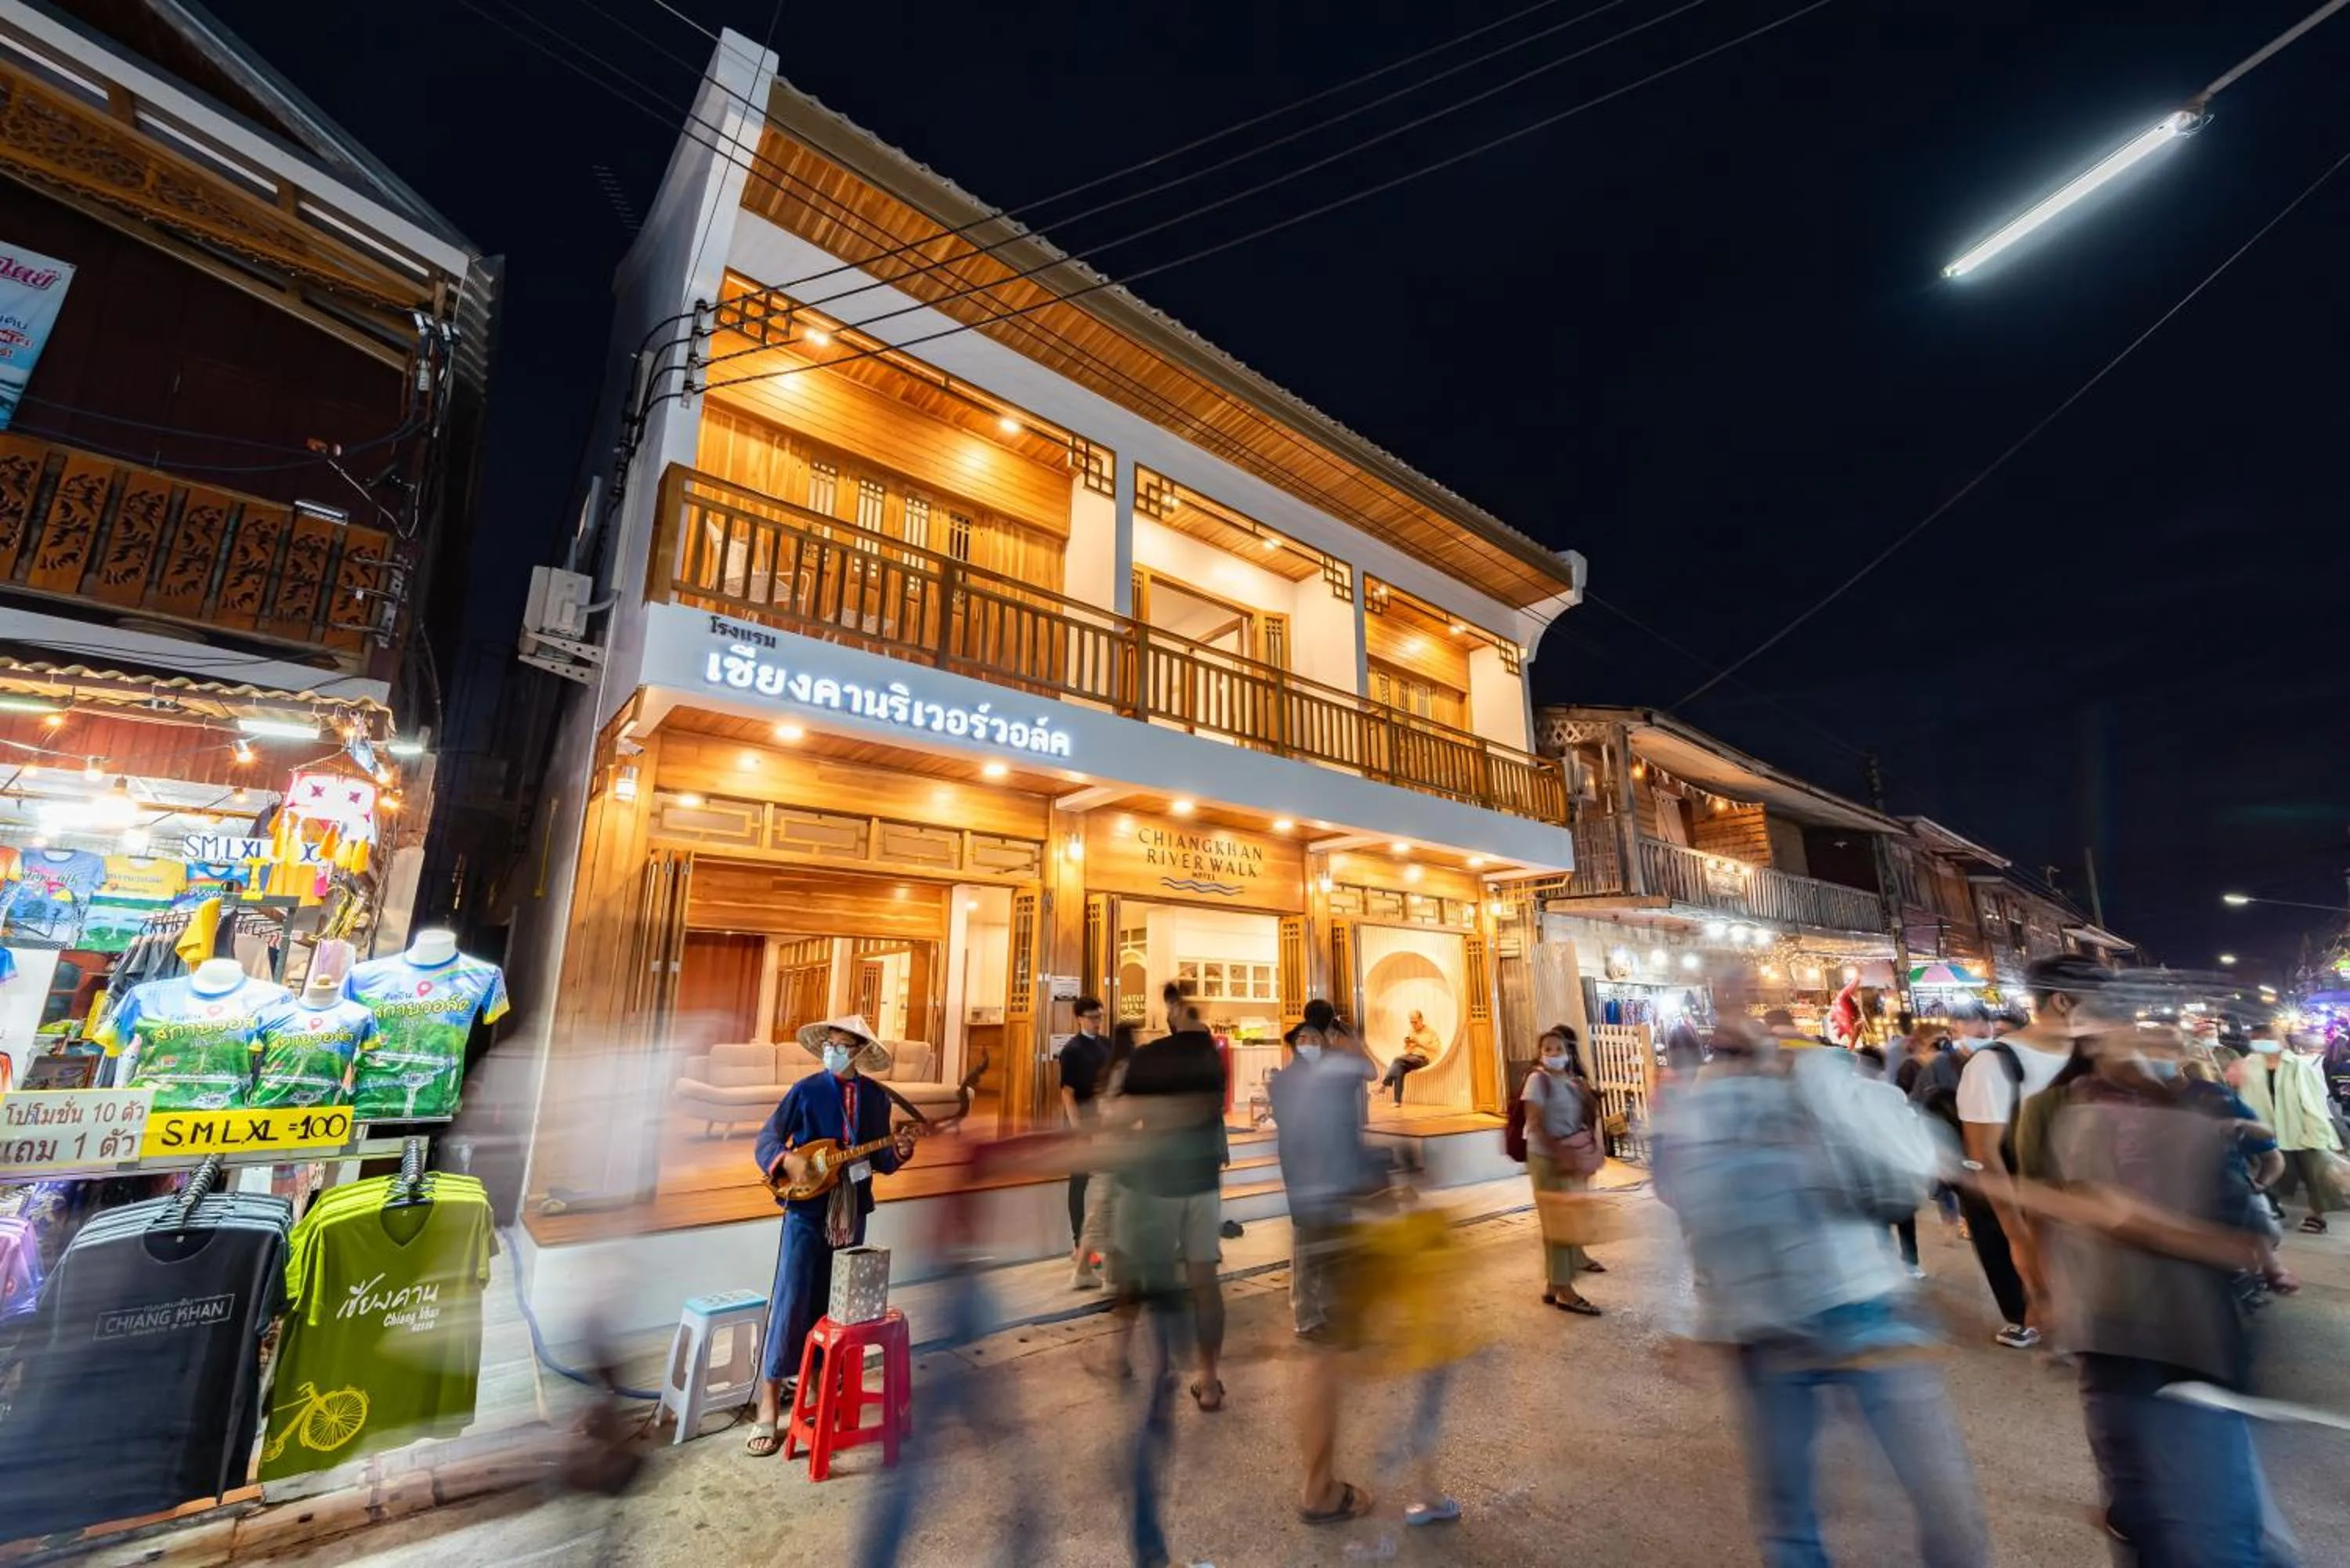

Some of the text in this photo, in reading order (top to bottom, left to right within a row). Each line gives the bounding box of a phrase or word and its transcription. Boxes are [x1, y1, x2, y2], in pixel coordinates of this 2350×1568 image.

[710, 615, 776, 649] โรงแรม
[705, 643, 1071, 757] เชียงคานริเวอร์วอล์ค
[1138, 828, 1263, 861] CHIANGKHAN
[1147, 848, 1257, 878] RIVER WALK
[94, 1102, 116, 1122] 10
[121, 1100, 145, 1122] ตัว
[74, 1132, 87, 1159] 1
[99, 1129, 136, 1158] ตัว
[105, 1310, 172, 1333] CHIANG
[175, 1300, 225, 1323] KHAN
